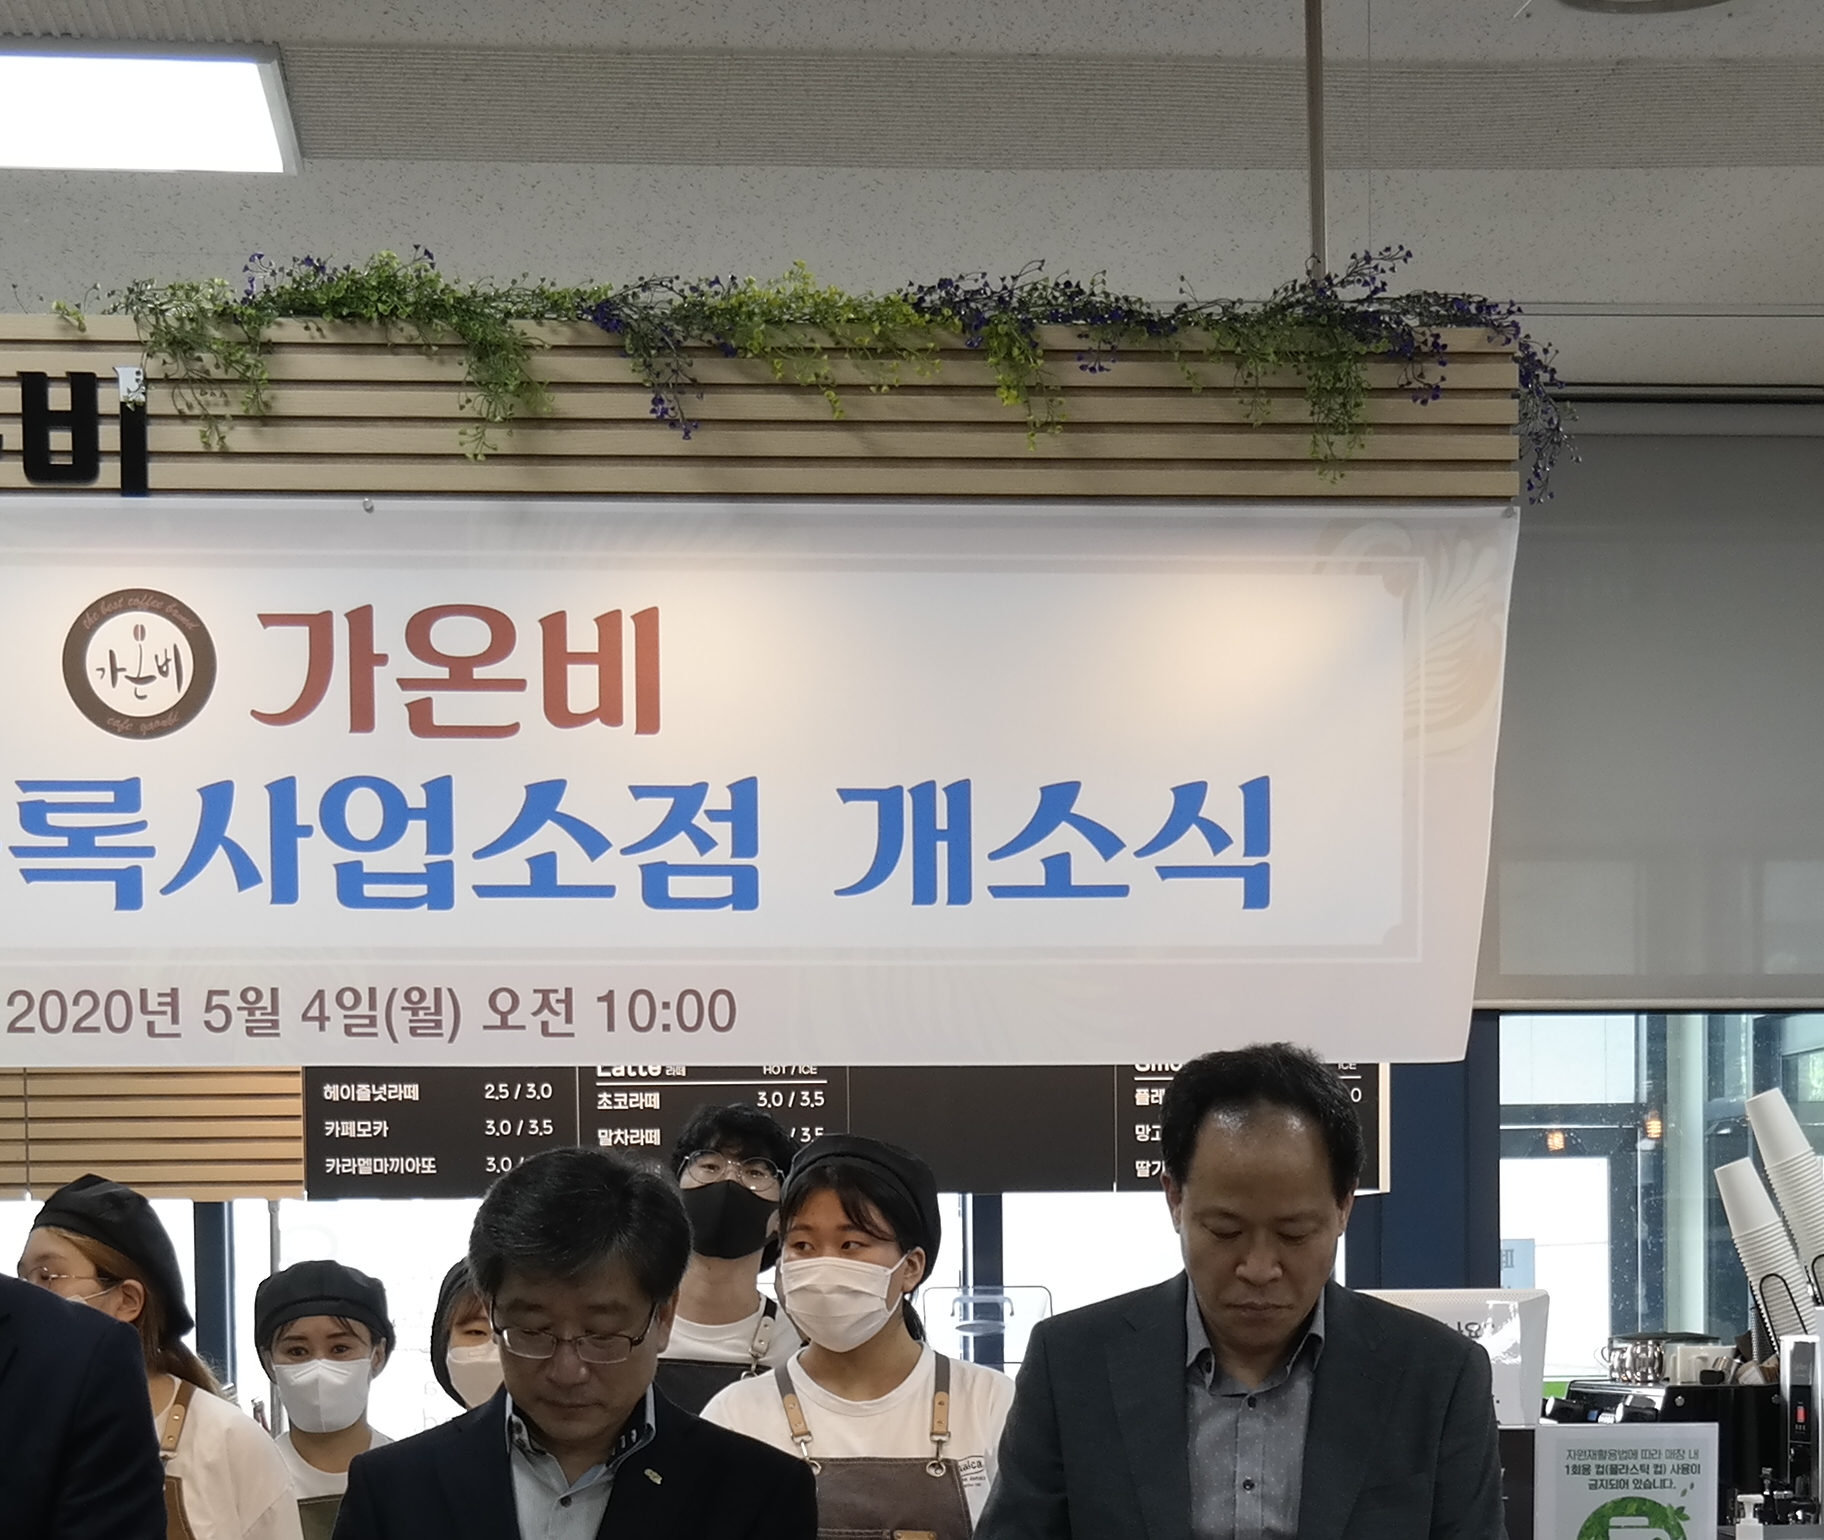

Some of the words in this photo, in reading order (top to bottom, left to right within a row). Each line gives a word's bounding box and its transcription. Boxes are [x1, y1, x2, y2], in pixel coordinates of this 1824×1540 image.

[100, 597, 125, 616] best
[127, 594, 164, 612] coffee
[250, 602, 663, 740] 가온비
[833, 774, 1273, 911] 개소식
[6, 988, 183, 1041] 2020년
[203, 986, 282, 1040] 5월
[301, 982, 463, 1046] 4일(월)
[482, 983, 578, 1039] 오전
[596, 987, 739, 1036] 10:00
[324, 1082, 419, 1102] 헤이즐넛라떼
[484, 1083, 511, 1099] 2.5
[525, 1083, 553, 1099] 3.0
[597, 1092, 661, 1111] 초코라떼
[756, 1091, 783, 1108] 3.0
[798, 1090, 826, 1107] 3.5
[325, 1119, 390, 1139] 카페모카
[484, 1120, 511, 1136] 3.0
[526, 1120, 554, 1136] 3.5
[597, 1128, 662, 1147] 말차라떼
[325, 1156, 438, 1176] 카라멜마끼아또
[485, 1156, 512, 1173] 3.0
[1566, 1449, 1638, 1461] 자원재활용법에
[1641, 1449, 1663, 1460] 따라
[1564, 1463, 1592, 1476] 1회용
[1669, 1463, 1701, 1476] 사용이
[1588, 1478, 1630, 1490] 금지되어
[1632, 1478, 1677, 1490] 있습니다.
